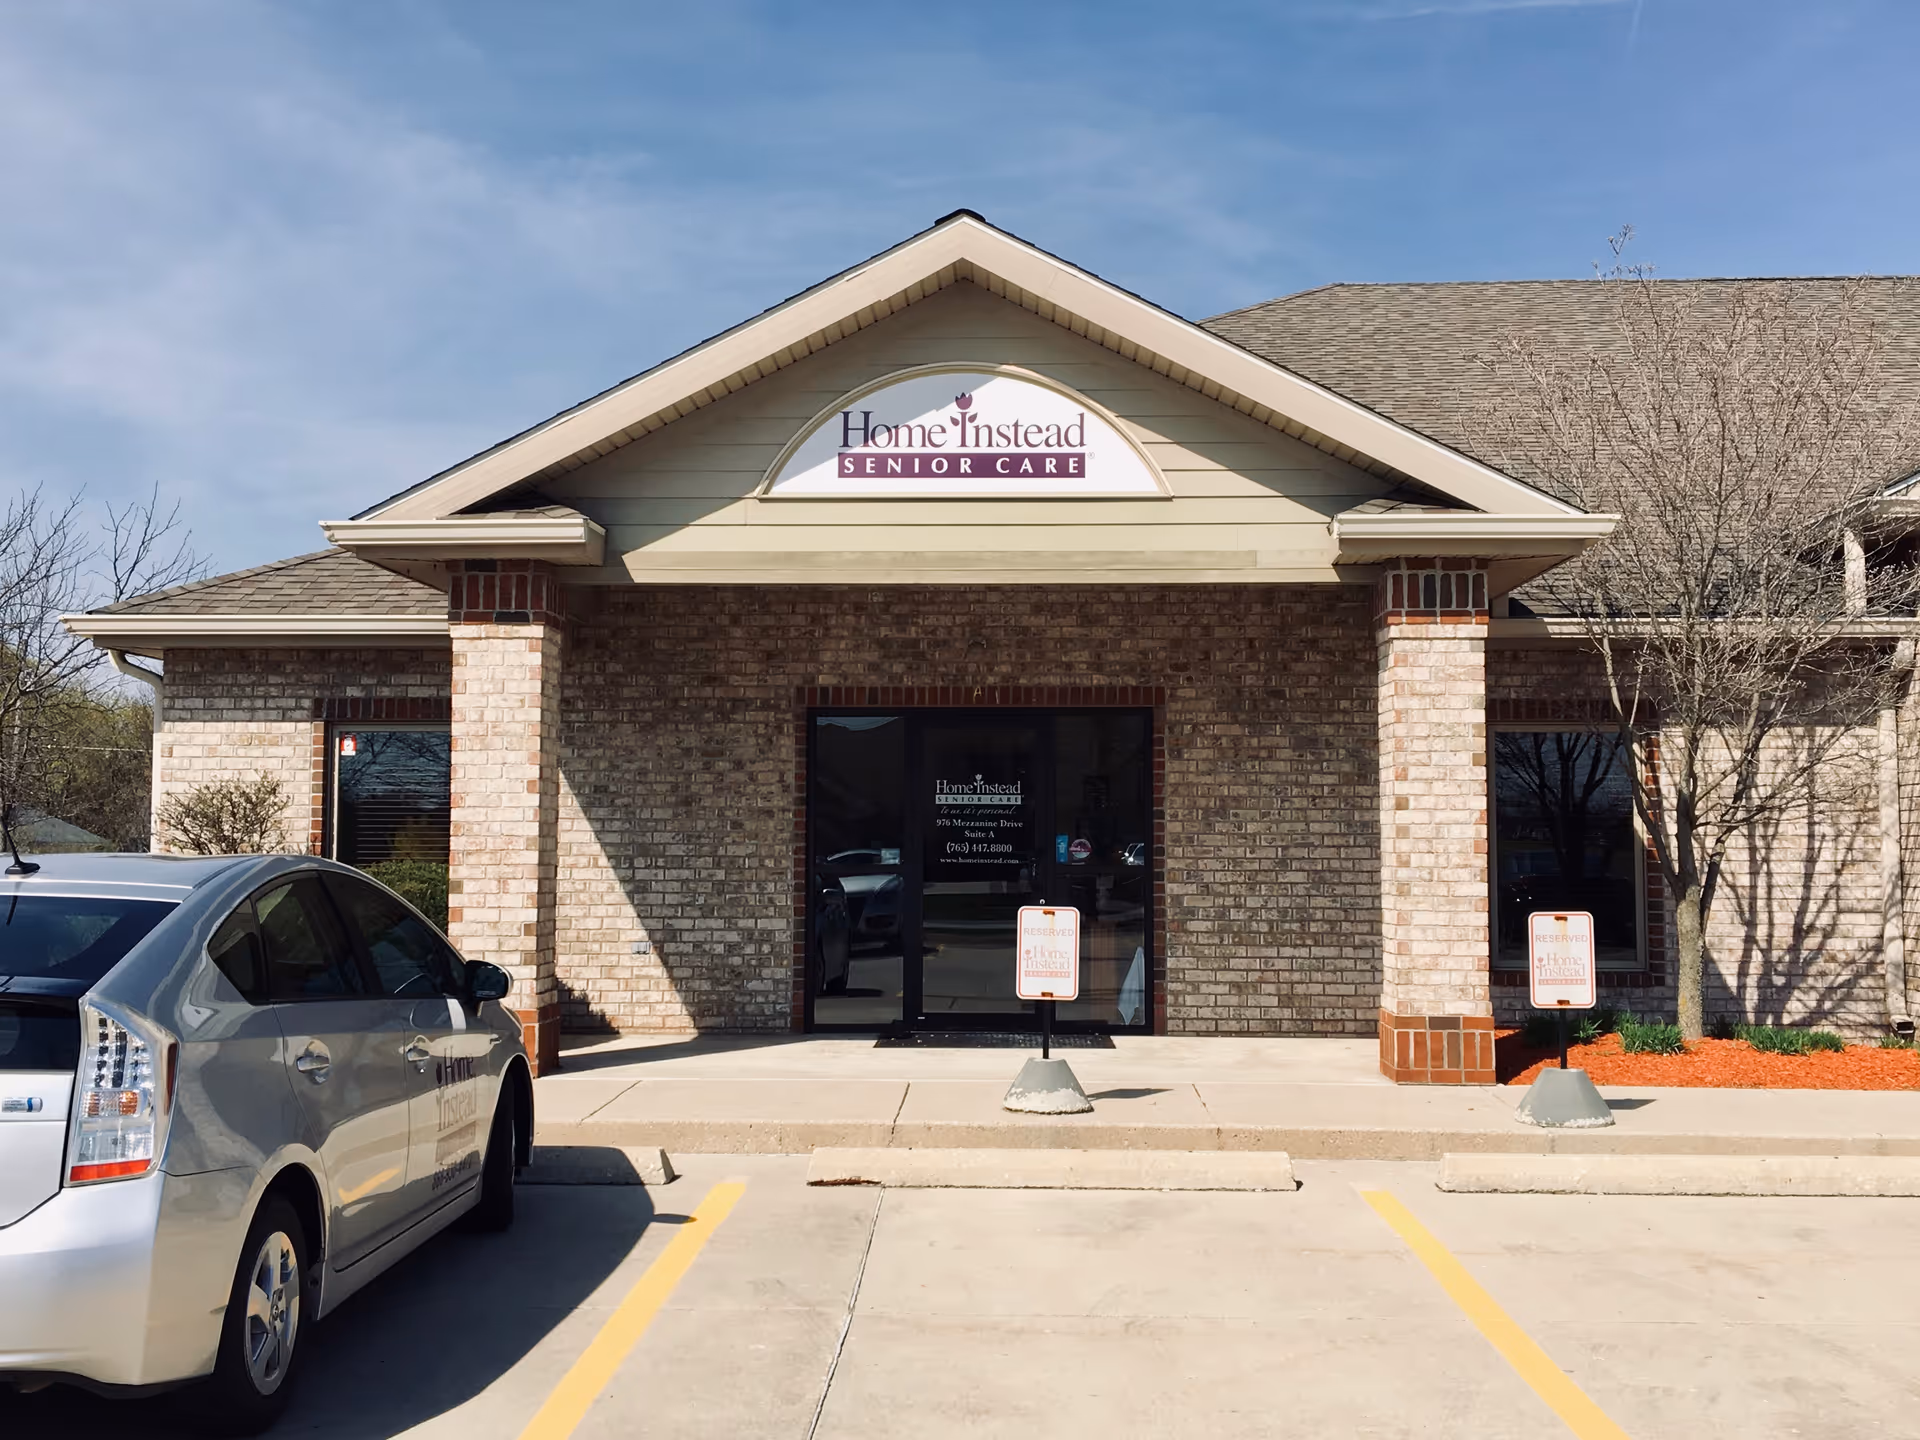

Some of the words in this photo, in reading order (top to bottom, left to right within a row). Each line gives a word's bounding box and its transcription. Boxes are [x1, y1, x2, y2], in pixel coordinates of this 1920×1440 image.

[838, 410, 947, 448] Home
[950, 410, 1087, 448] Instead
[843, 457, 973, 474] SENIOR
[996, 457, 1080, 474] CARE
[936, 780, 974, 794] Home
[974, 780, 1021, 794] Instead
[936, 819, 951, 827] 976
[952, 819, 998, 827] Mezzanine
[1000, 819, 1023, 828] Drive
[964, 830, 986, 838] Suite
[988, 830, 995, 838] A
[946, 841, 969, 854] (765)
[971, 843, 1013, 853] 447.8800
[1023, 927, 1074, 937] RESERVED
[1535, 934, 1588, 943] RESERVED
[1033, 945, 1068, 959] Home
[1546, 952, 1582, 966] Home
[1024, 957, 1070, 970] Instead
[1537, 963, 1585, 977] Instead
[443, 1046, 476, 1088] Home
